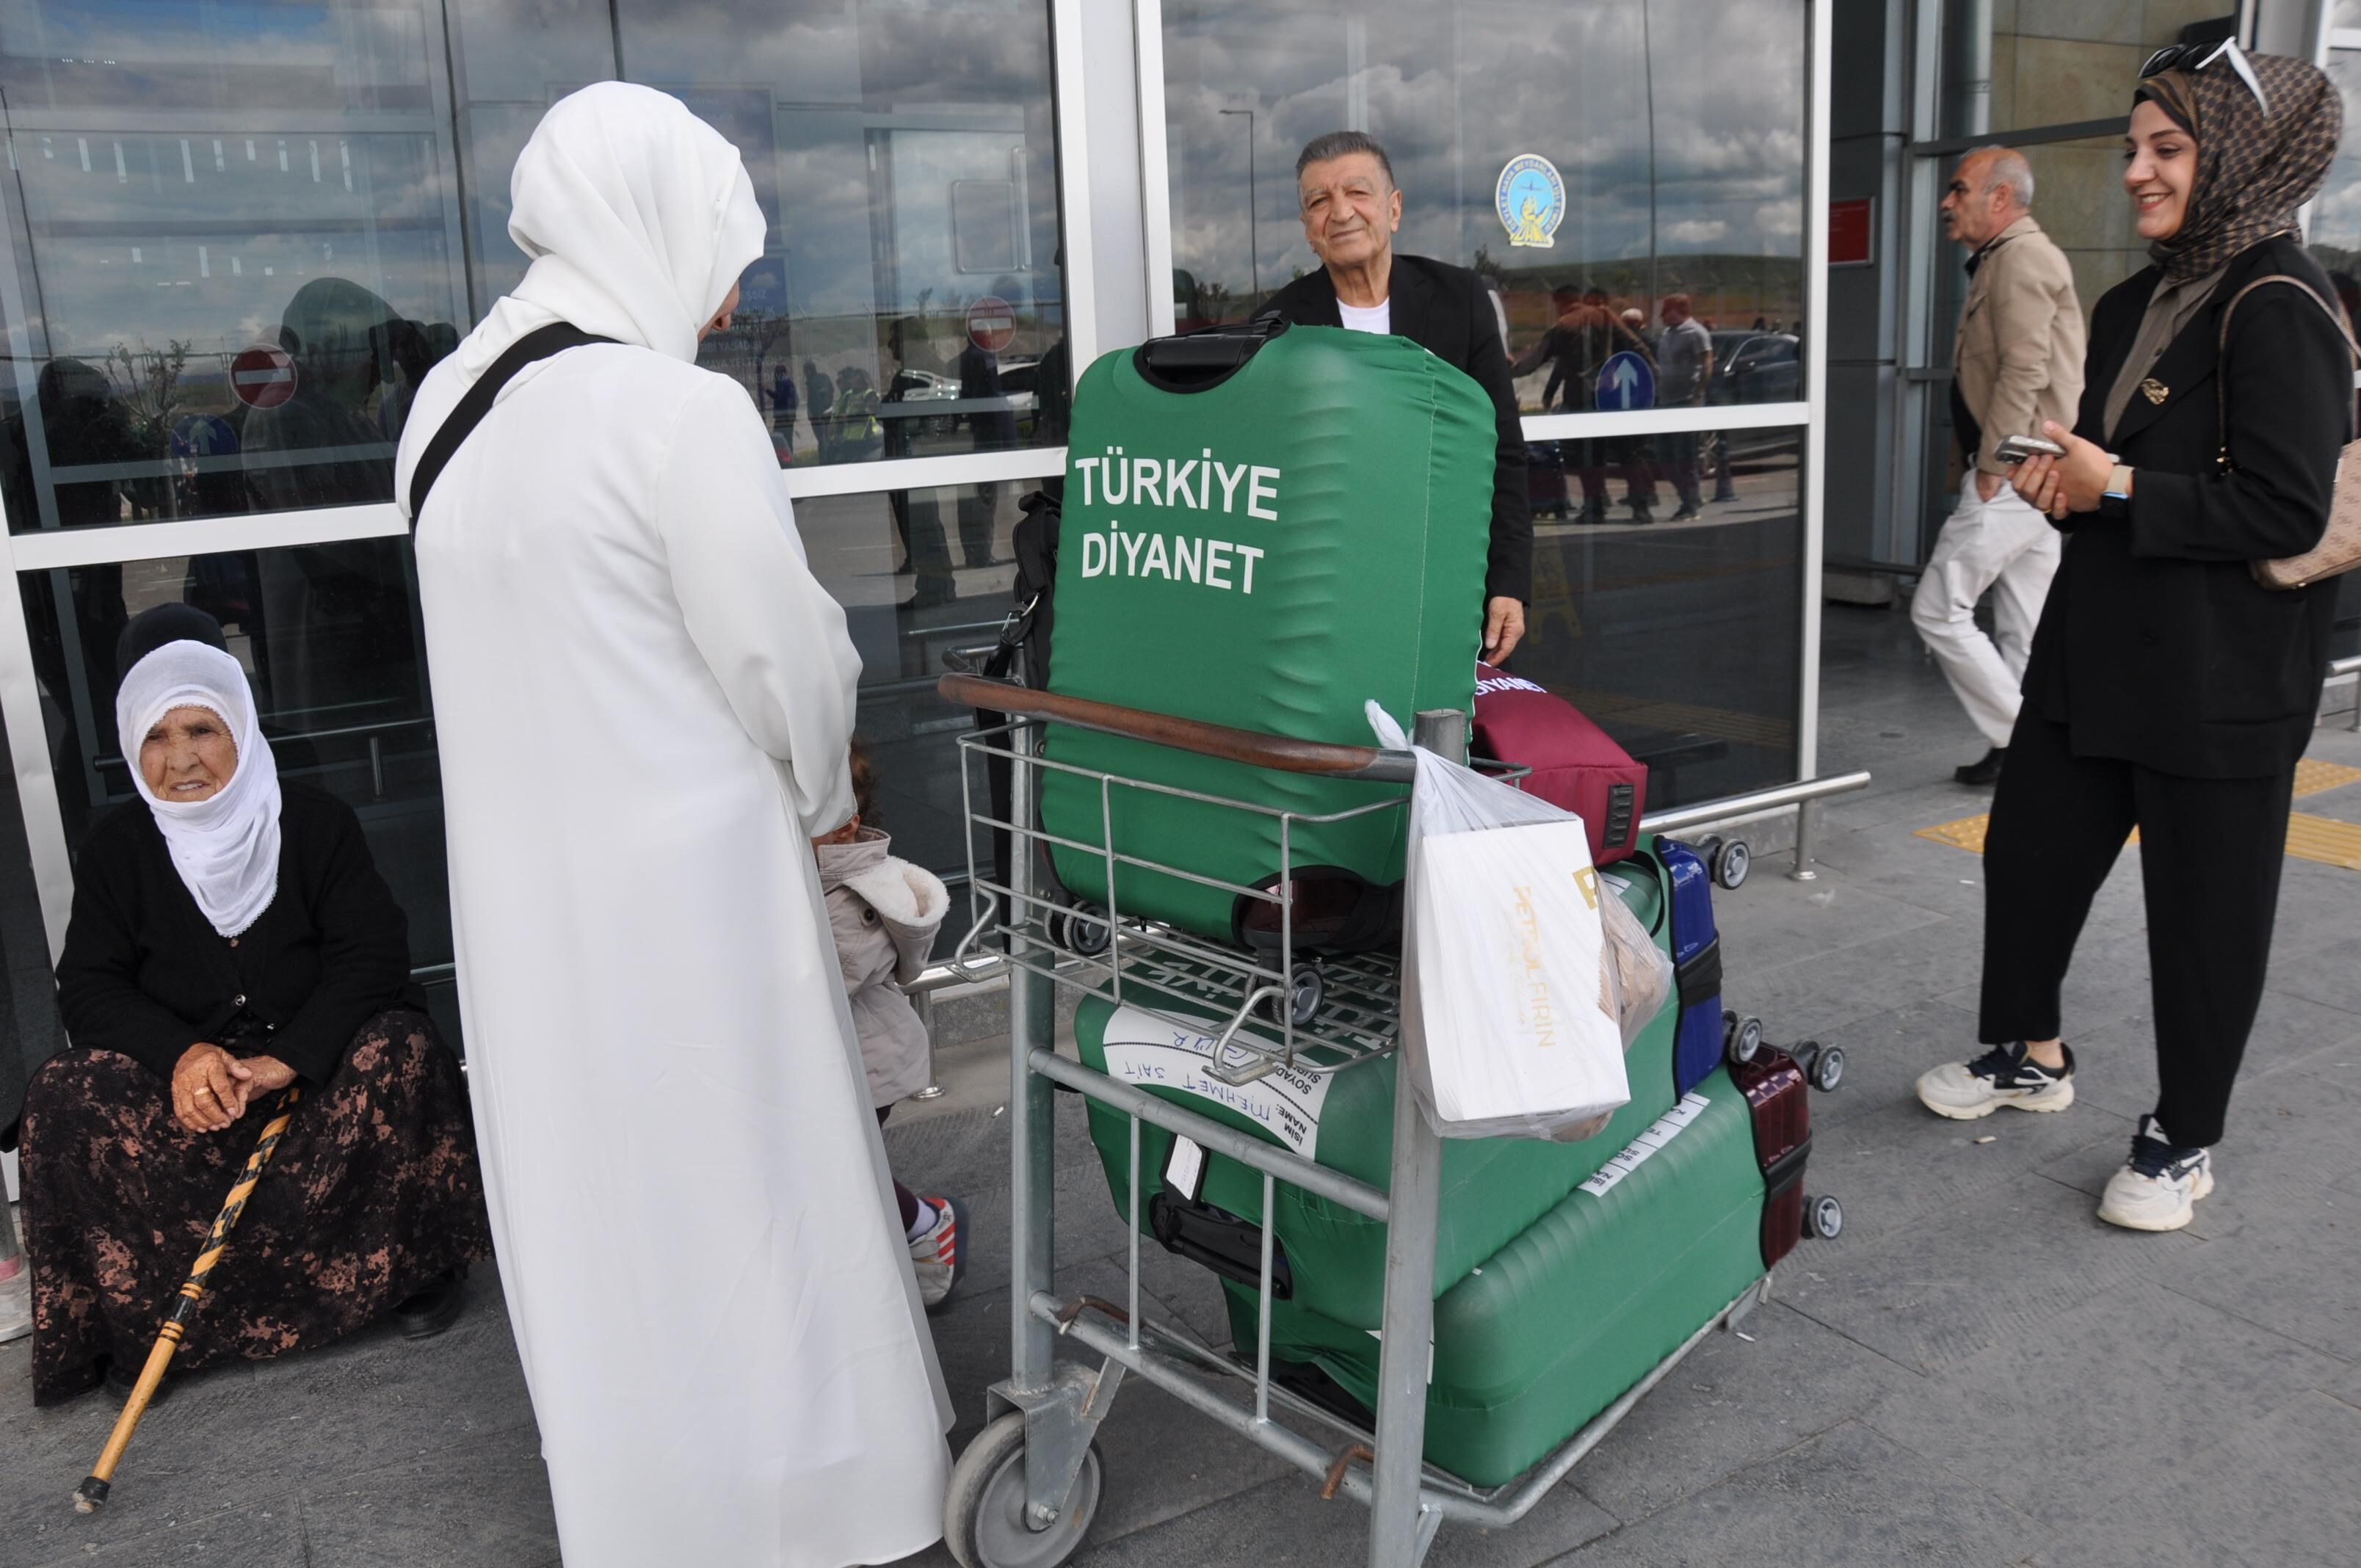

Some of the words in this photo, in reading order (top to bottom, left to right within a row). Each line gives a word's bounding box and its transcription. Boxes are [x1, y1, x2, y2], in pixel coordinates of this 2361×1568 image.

[1075, 446, 1280, 521] TÜRKİYE
[1081, 520, 1264, 595] DİYANET
[1124, 1061, 1165, 1079] SAİT
[1275, 1062, 1312, 1095] SOYAD
[1183, 1073, 1272, 1122] MEHMET
[1274, 1105, 1308, 1135] NAME:
